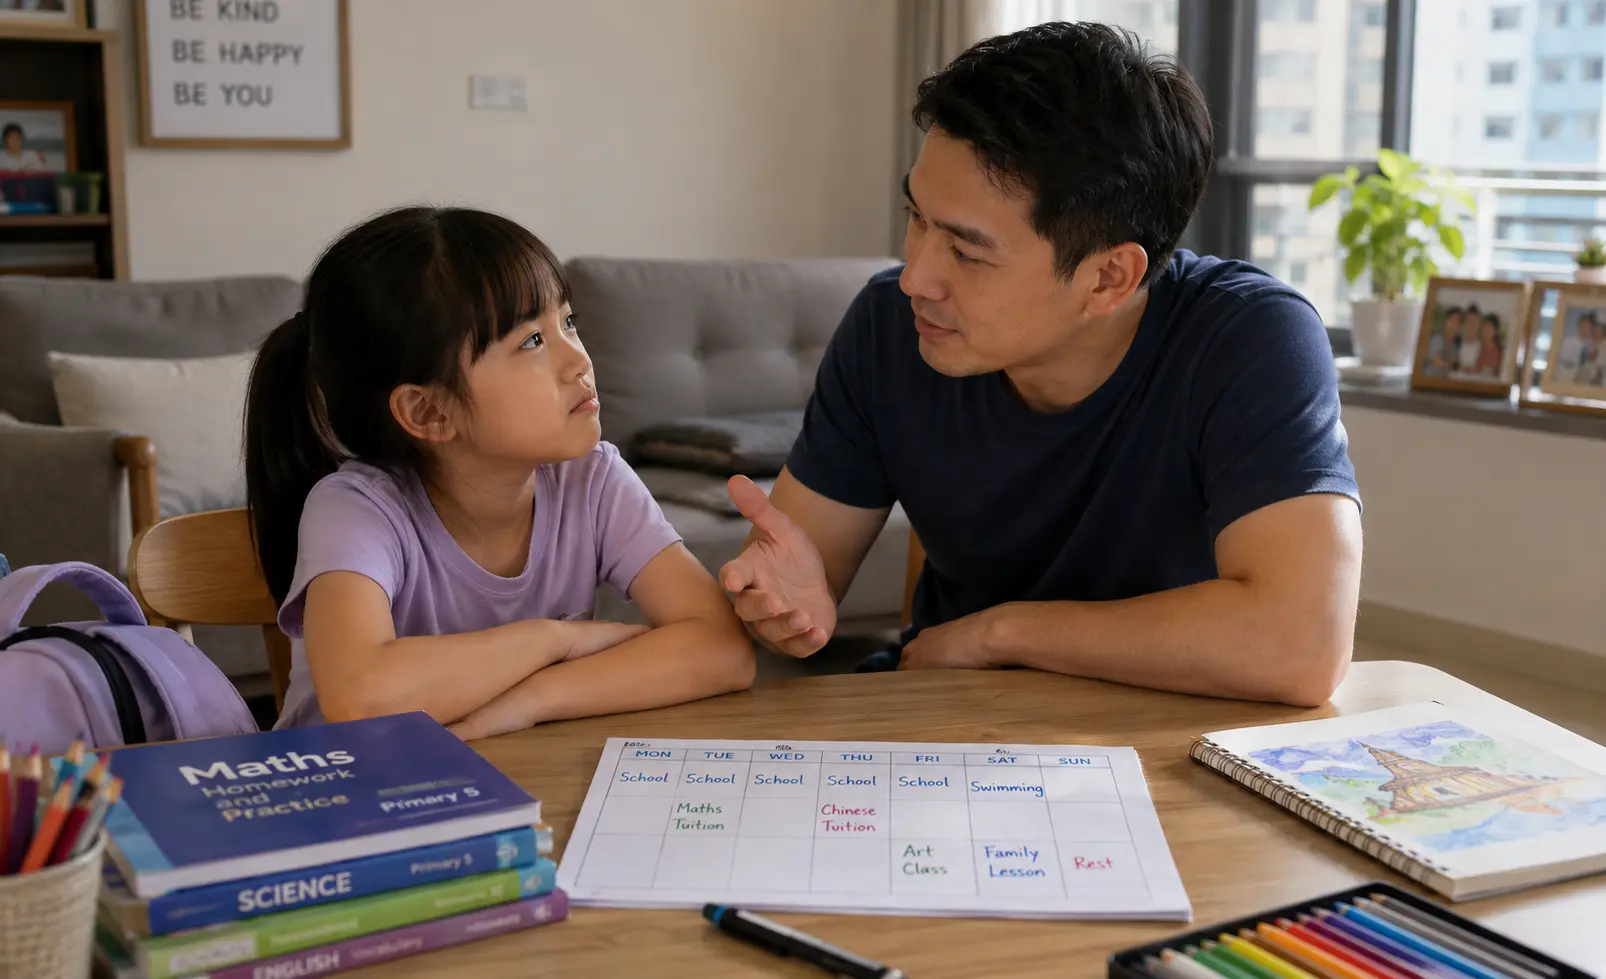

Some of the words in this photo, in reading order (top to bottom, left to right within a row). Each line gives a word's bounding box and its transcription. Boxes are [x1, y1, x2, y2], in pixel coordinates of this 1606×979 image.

[170, 0, 205, 21] BE
[217, 0, 280, 23] KIND
[172, 39, 205, 63] BE
[219, 42, 303, 66] HAPPY
[174, 82, 206, 106] BE
[220, 84, 273, 107] YOU
[178, 750, 355, 786] Maths
[635, 750, 671, 758] MON
[704, 751, 735, 760] TUE
[841, 753, 873, 761] THU
[915, 755, 940, 763] FRI
[987, 756, 1017, 764] SAT
[1059, 757, 1091, 765] SUN
[200, 768, 356, 798] Homework
[620, 771, 669, 783] School
[685, 773, 736, 784] School
[754, 774, 804, 785] School
[827, 775, 876, 786] School
[899, 776, 949, 787] School
[971, 781, 1044, 797] Swimming
[215, 792, 270, 809] and
[222, 795, 349, 822] Practice
[379, 791, 459, 813] Primary
[463, 786, 480, 798] 5
[676, 802, 722, 814] Maths
[821, 804, 876, 816] Chinese
[673, 818, 725, 830] Tuition
[821, 820, 876, 832] Tuition
[902, 862, 948, 876] Class
[989, 864, 1046, 878] Lesson
[903, 845, 934, 858] Art
[984, 846, 1039, 863] Family
[1074, 856, 1114, 870] Rest
[237, 871, 353, 912] SCIENCE
[252, 950, 340, 979] ENGLISH
